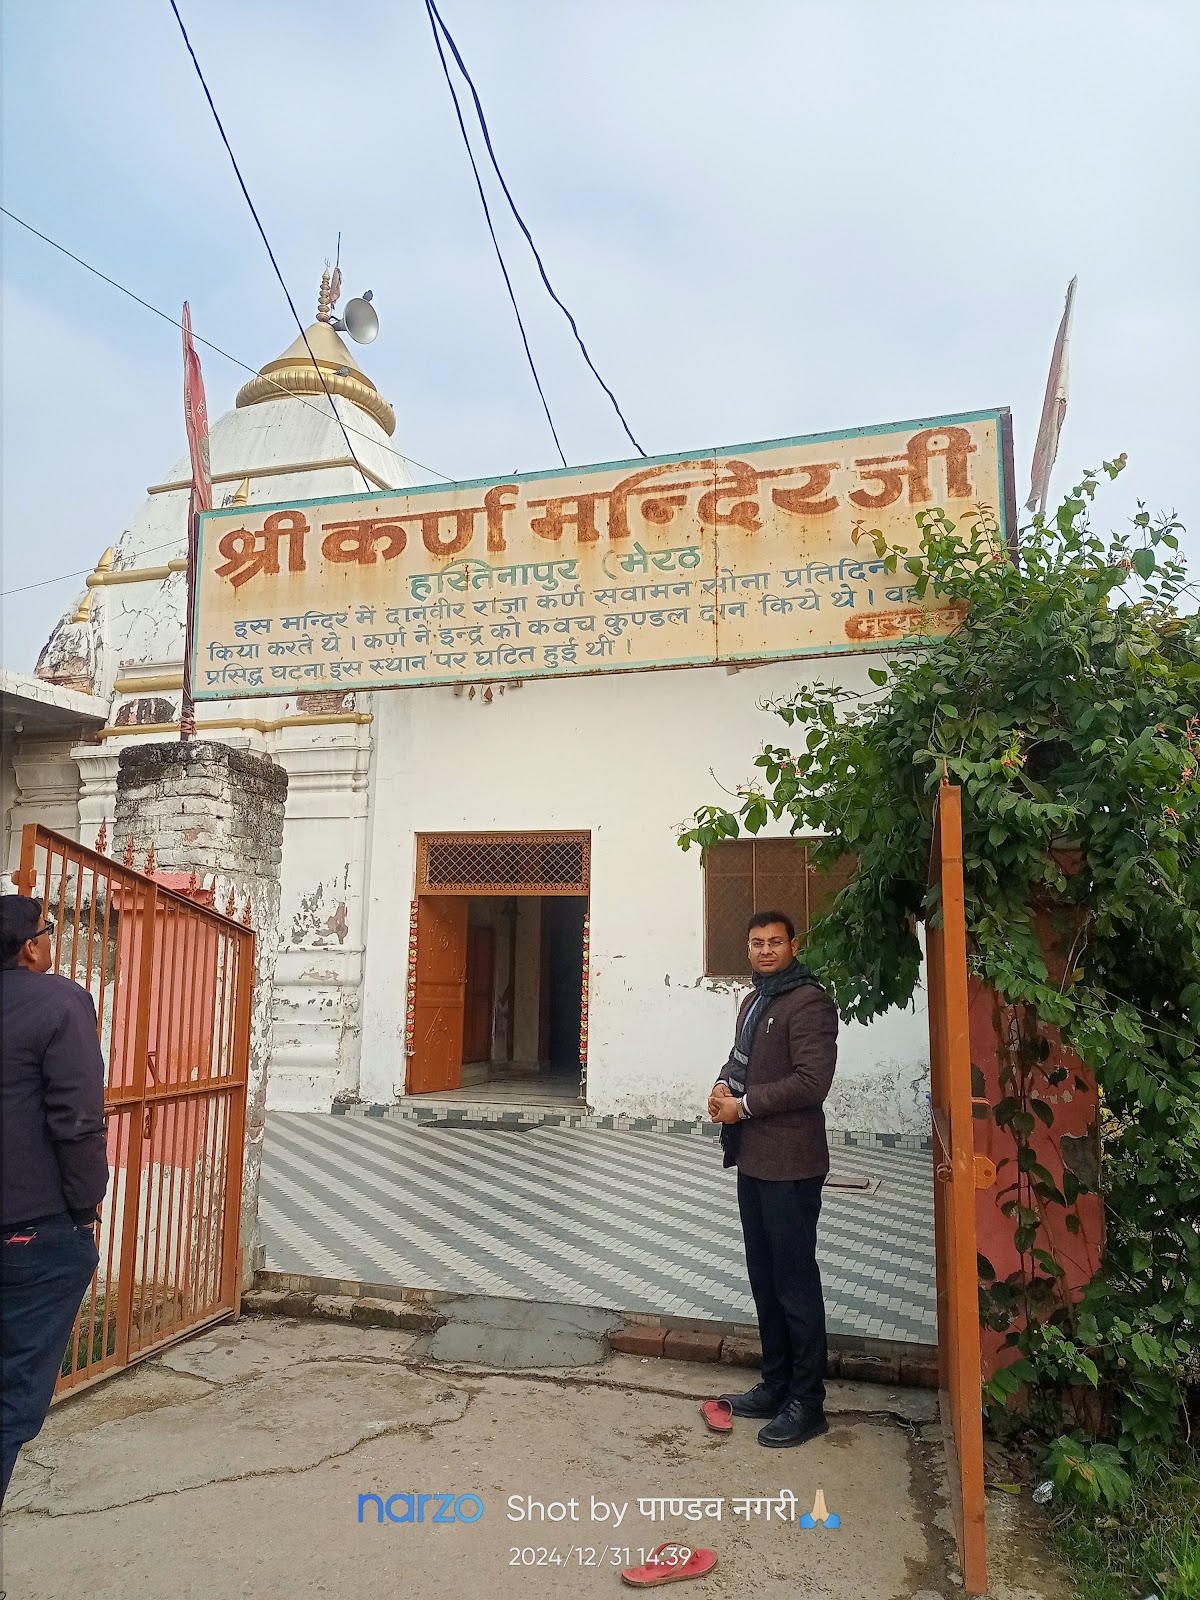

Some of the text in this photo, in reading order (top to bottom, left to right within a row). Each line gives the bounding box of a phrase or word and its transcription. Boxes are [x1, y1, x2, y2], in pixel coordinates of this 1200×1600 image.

[214, 426, 977, 587] श्री कर्ण मन्दिर जी
[234, 618, 273, 639] इस
[280, 610, 349, 631] मन्दिर
[385, 597, 467, 626] दानवीर
[472, 597, 528, 616] राजा
[536, 584, 585, 609] कर्ण
[593, 582, 693, 606] सवामन
[699, 568, 771, 596] सोना
[408, 558, 579, 602] हस्तिनापुर
[206, 642, 260, 661] किया
[267, 633, 314, 656] करते
[321, 632, 342, 652] थे
[363, 626, 407, 649] कर्ण
[413, 624, 432, 645] ने
[437, 625, 484, 648] इन्द्र
[489, 616, 521, 639] को
[528, 615, 597, 636] कवच
[604, 608, 691, 636] कुण्डल
[700, 602, 747, 623] दान
[761, 588, 821, 616] किये
[831, 584, 857, 608] थे
[205, 662, 265, 686] प्रसिद्ध
[270, 663, 325, 680] घटना
[329, 661, 363, 682] इस
[369, 655, 427, 676] स्थान
[434, 652, 468, 669] पर
[473, 644, 537, 666] घटित
[543, 637, 579, 669] हुई
[585, 634, 615, 656] थी
